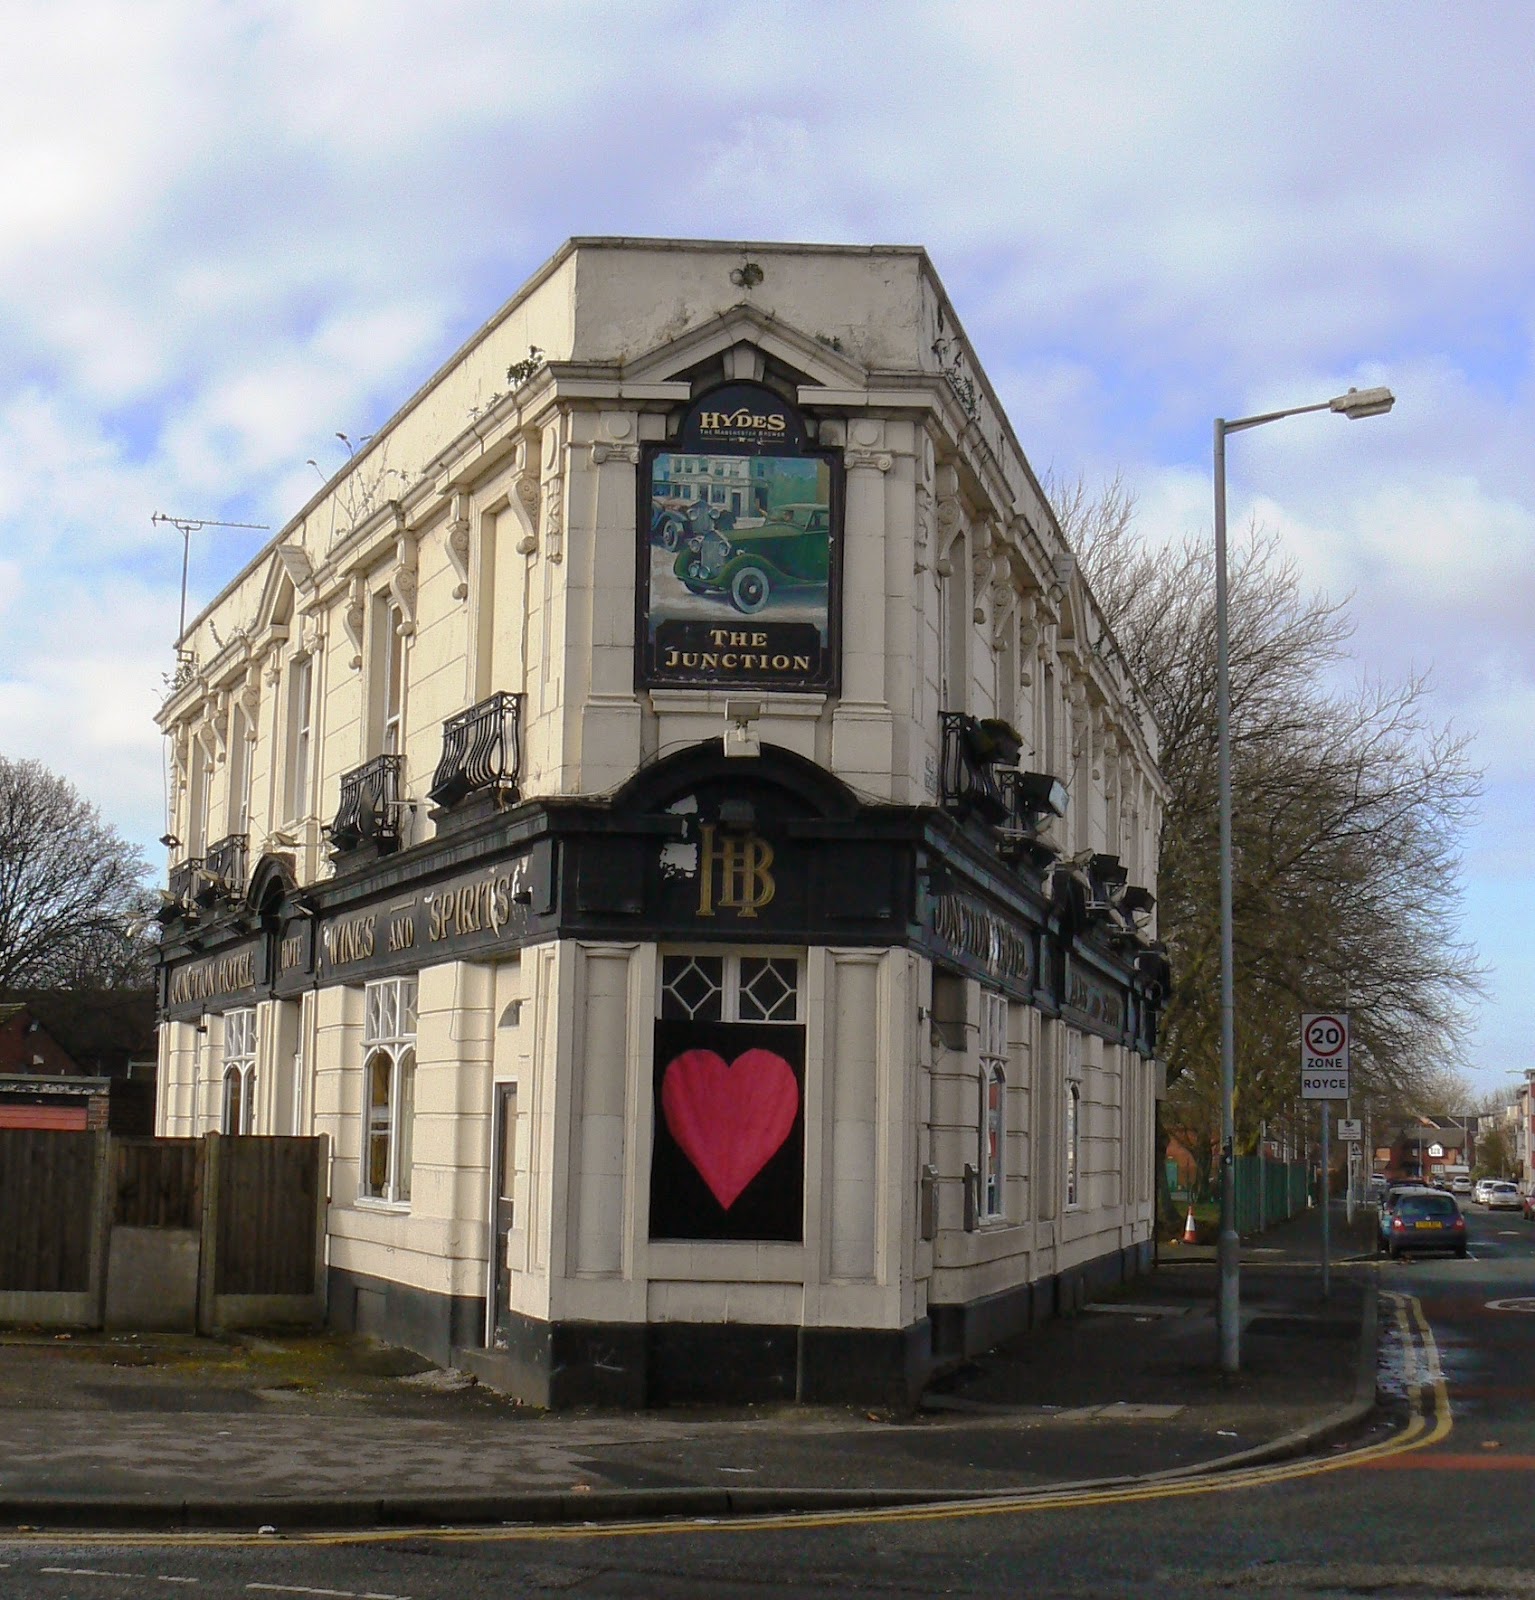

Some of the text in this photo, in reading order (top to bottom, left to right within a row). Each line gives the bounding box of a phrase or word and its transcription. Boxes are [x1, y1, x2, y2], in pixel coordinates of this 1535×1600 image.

[700, 408, 786, 431] HYDES
[710, 629, 768, 647] THE
[665, 651, 810, 670] JUNCTION
[328, 873, 512, 965] WINES AND SPIRITS
[219, 950, 255, 993] HOTEL
[1311, 1028, 1339, 1044] 20
[1307, 1058, 1343, 1068] ZONE
[1303, 1079, 1346, 1089] ROYCE
